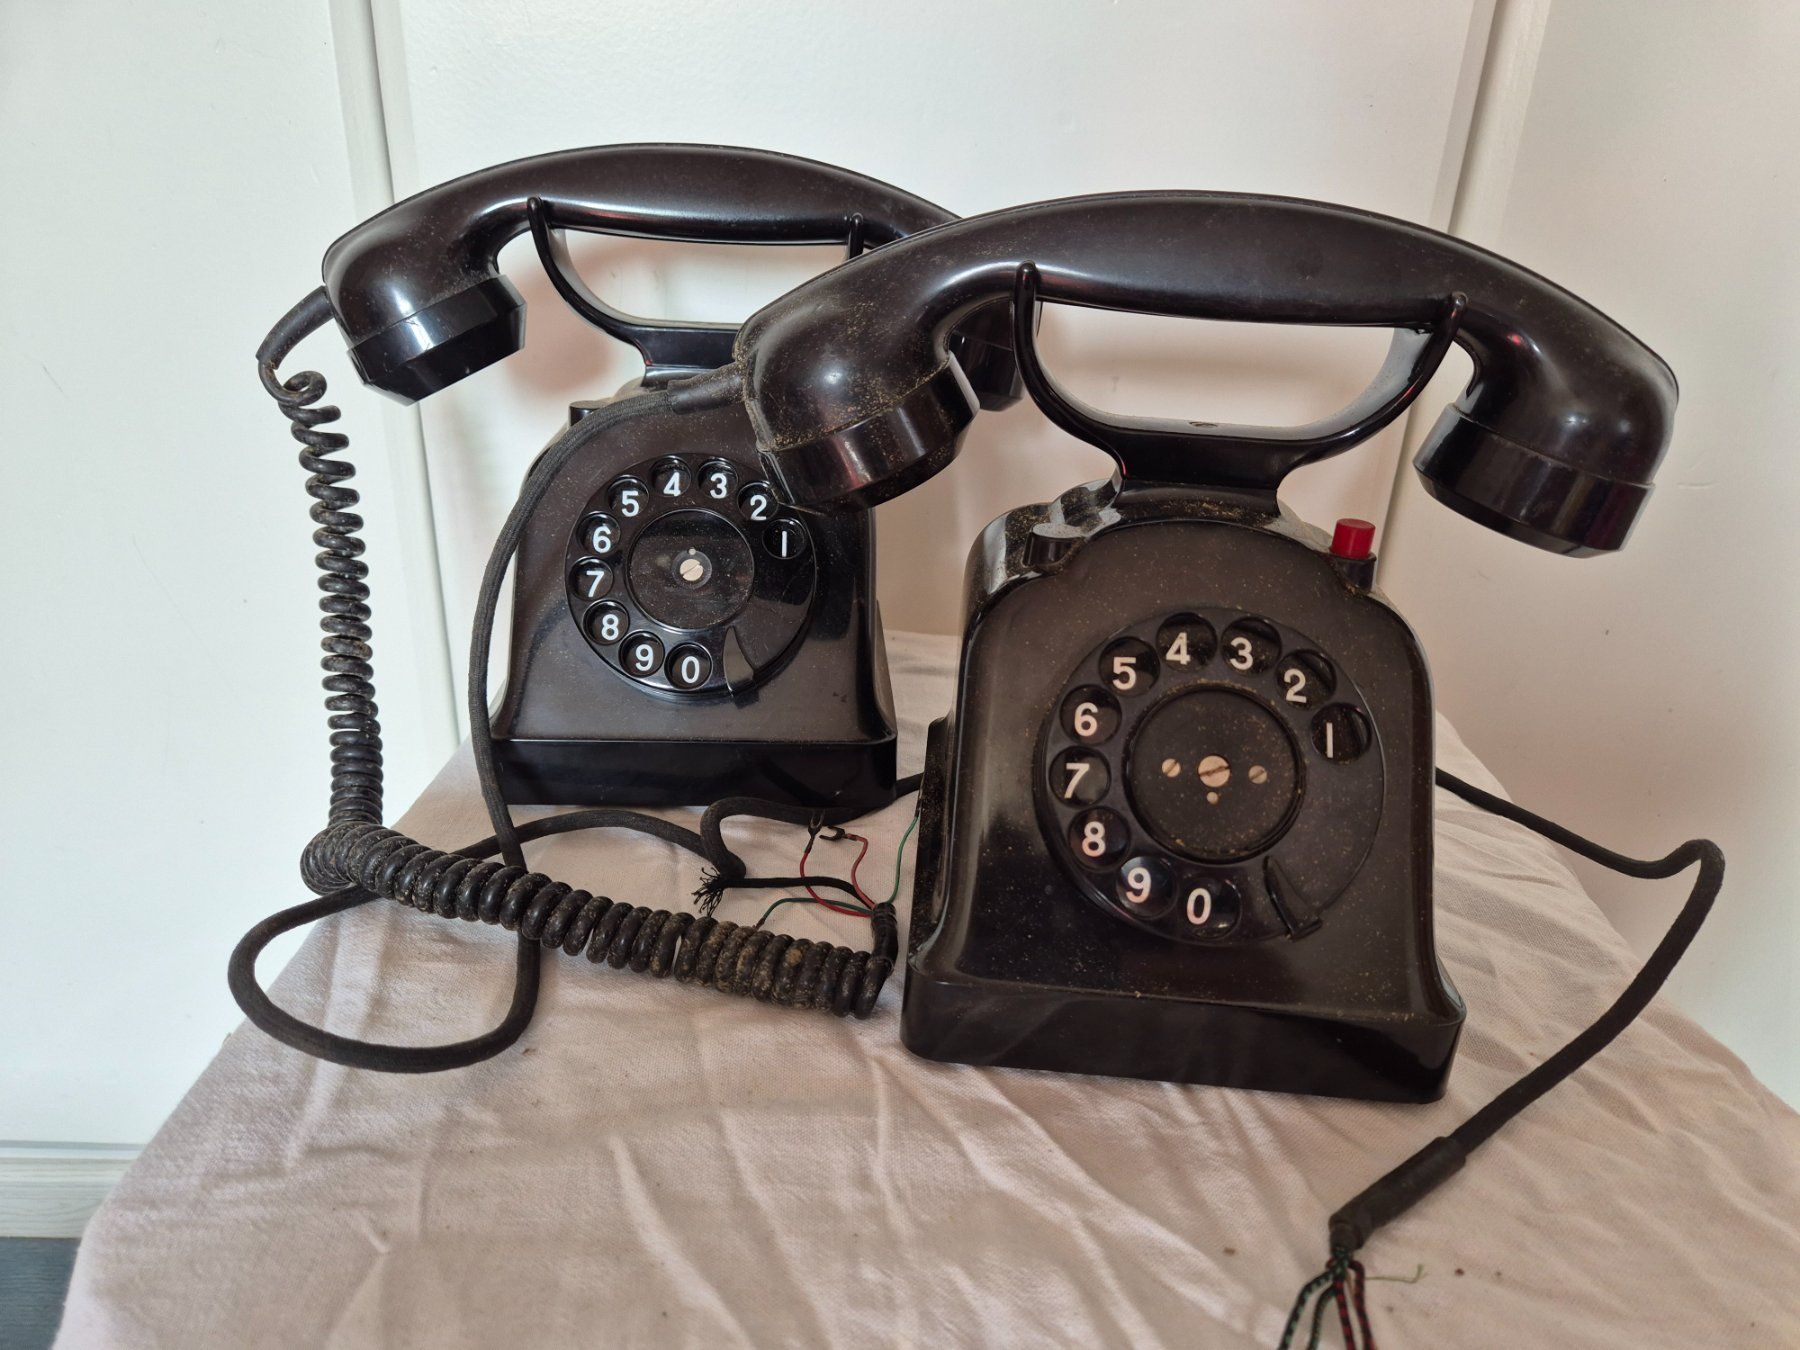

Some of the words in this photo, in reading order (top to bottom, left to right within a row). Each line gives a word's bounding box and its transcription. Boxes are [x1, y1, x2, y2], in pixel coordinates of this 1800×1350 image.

[663, 471, 681, 497] 4
[709, 472, 728, 499] 3
[621, 490, 640, 518] 5
[750, 494, 767, 521] 2
[592, 526, 612, 554] 6
[781, 530, 788, 557] 1
[586, 570, 605, 598] 7
[601, 613, 620, 641] 8
[635, 643, 654, 672] 9
[1166, 632, 1191, 665] 4
[1230, 637, 1253, 670] 3
[681, 655, 700, 684] 0
[1113, 656, 1136, 690] 5
[1284, 668, 1307, 703] 2
[1074, 702, 1098, 737] 6
[1326, 723, 1333, 758] 1
[1065, 762, 1090, 798] 7
[1082, 821, 1106, 856] 8
[1126, 866, 1152, 903] 9
[1187, 888, 1211, 925] 0
